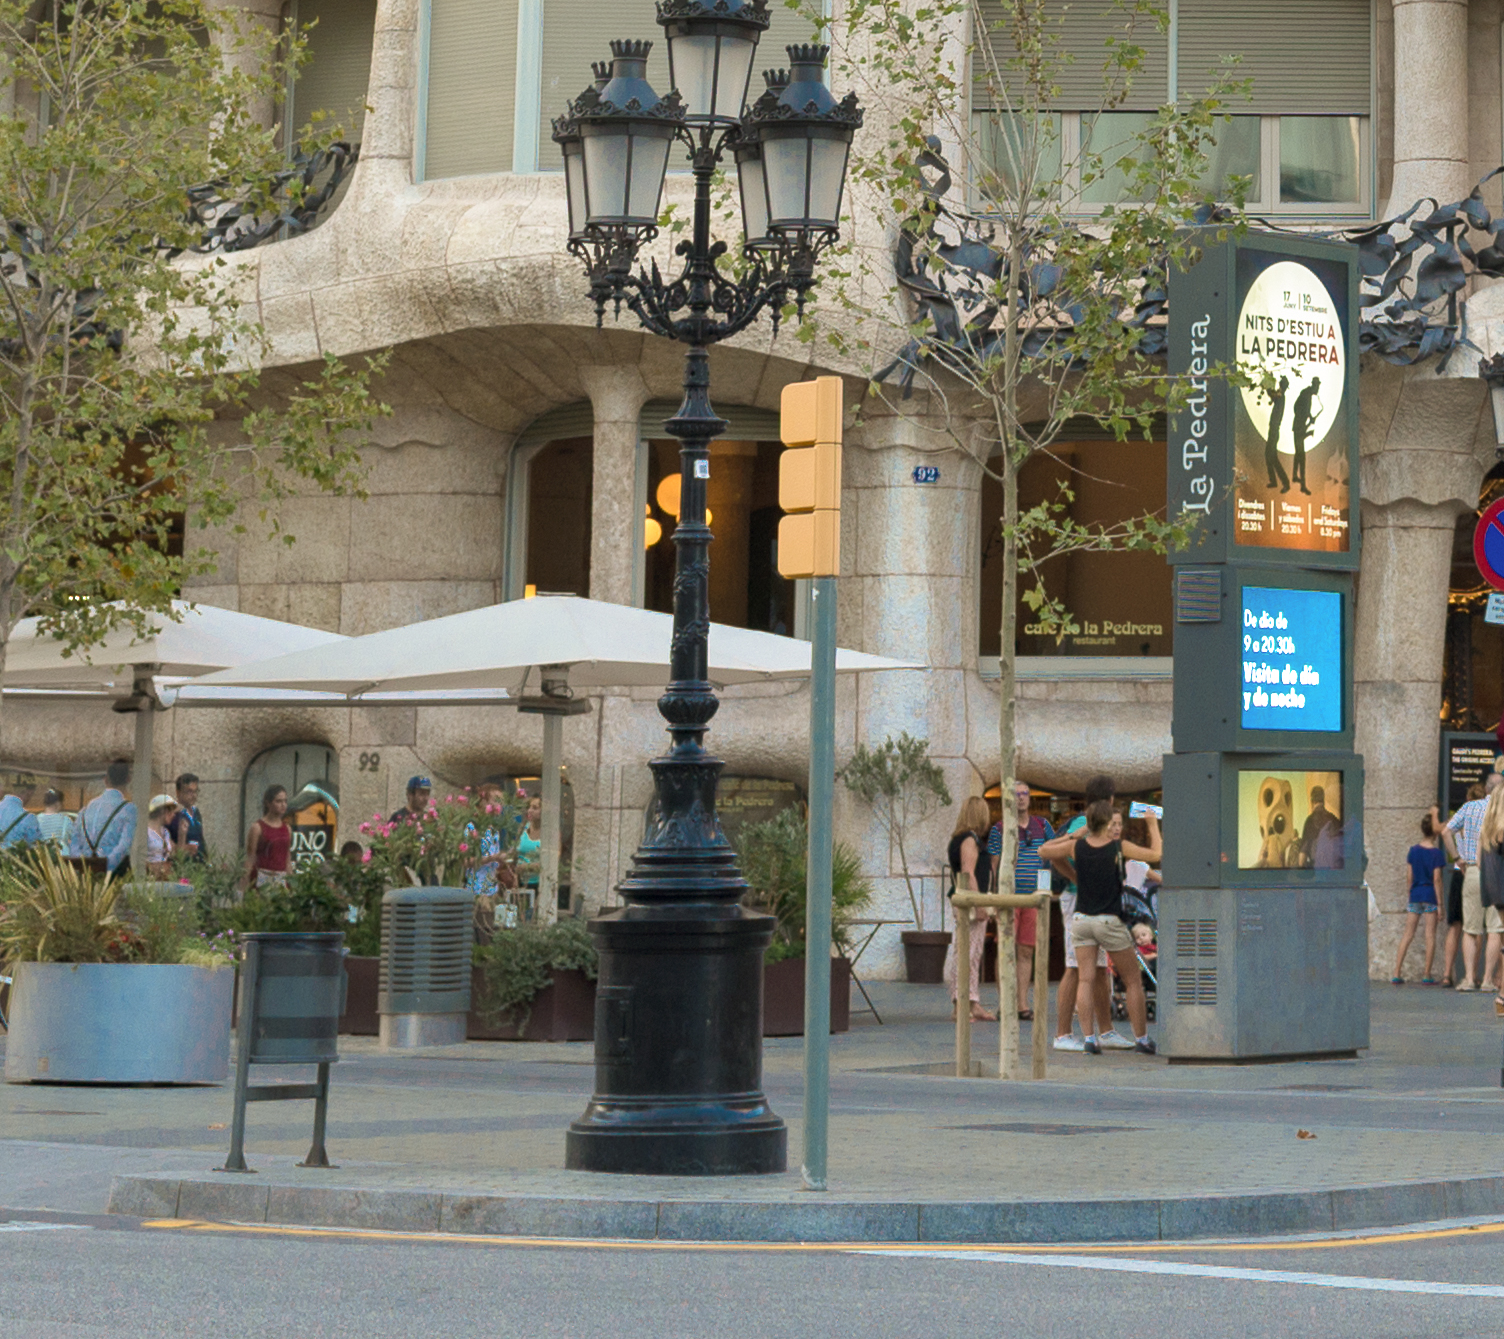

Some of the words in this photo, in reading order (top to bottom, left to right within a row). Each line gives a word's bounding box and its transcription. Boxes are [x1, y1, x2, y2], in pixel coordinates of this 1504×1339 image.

[1283, 291, 1291, 302] 17
[1303, 293, 1312, 305] 10
[1303, 305, 1328, 314] SETEMBRE
[1245, 314, 1273, 332] NITS
[1277, 318, 1324, 338] D'ESTIU
[1327, 325, 1336, 340] A
[1242, 334, 1261, 355] LA
[1266, 337, 1339, 365] PEDRERA
[1183, 314, 1211, 471] Pedrera
[917, 467, 936, 481] 92
[1183, 475, 1214, 516] La
[1084, 620, 1098, 635] la
[1103, 620, 1163, 635] Pedrera
[1244, 608, 1257, 628] De
[1276, 611, 1288, 629] de
[1073, 636, 1116, 645] restaurant
[1244, 634, 1252, 652] 9
[1252, 640, 1260, 652] a
[1261, 635, 1295, 654] 20.30h
[1243, 661, 1279, 684] Visita
[1282, 663, 1298, 685] de
[1243, 692, 1251, 711] y
[1253, 686, 1269, 707] de
[1270, 687, 1305, 708] noche
